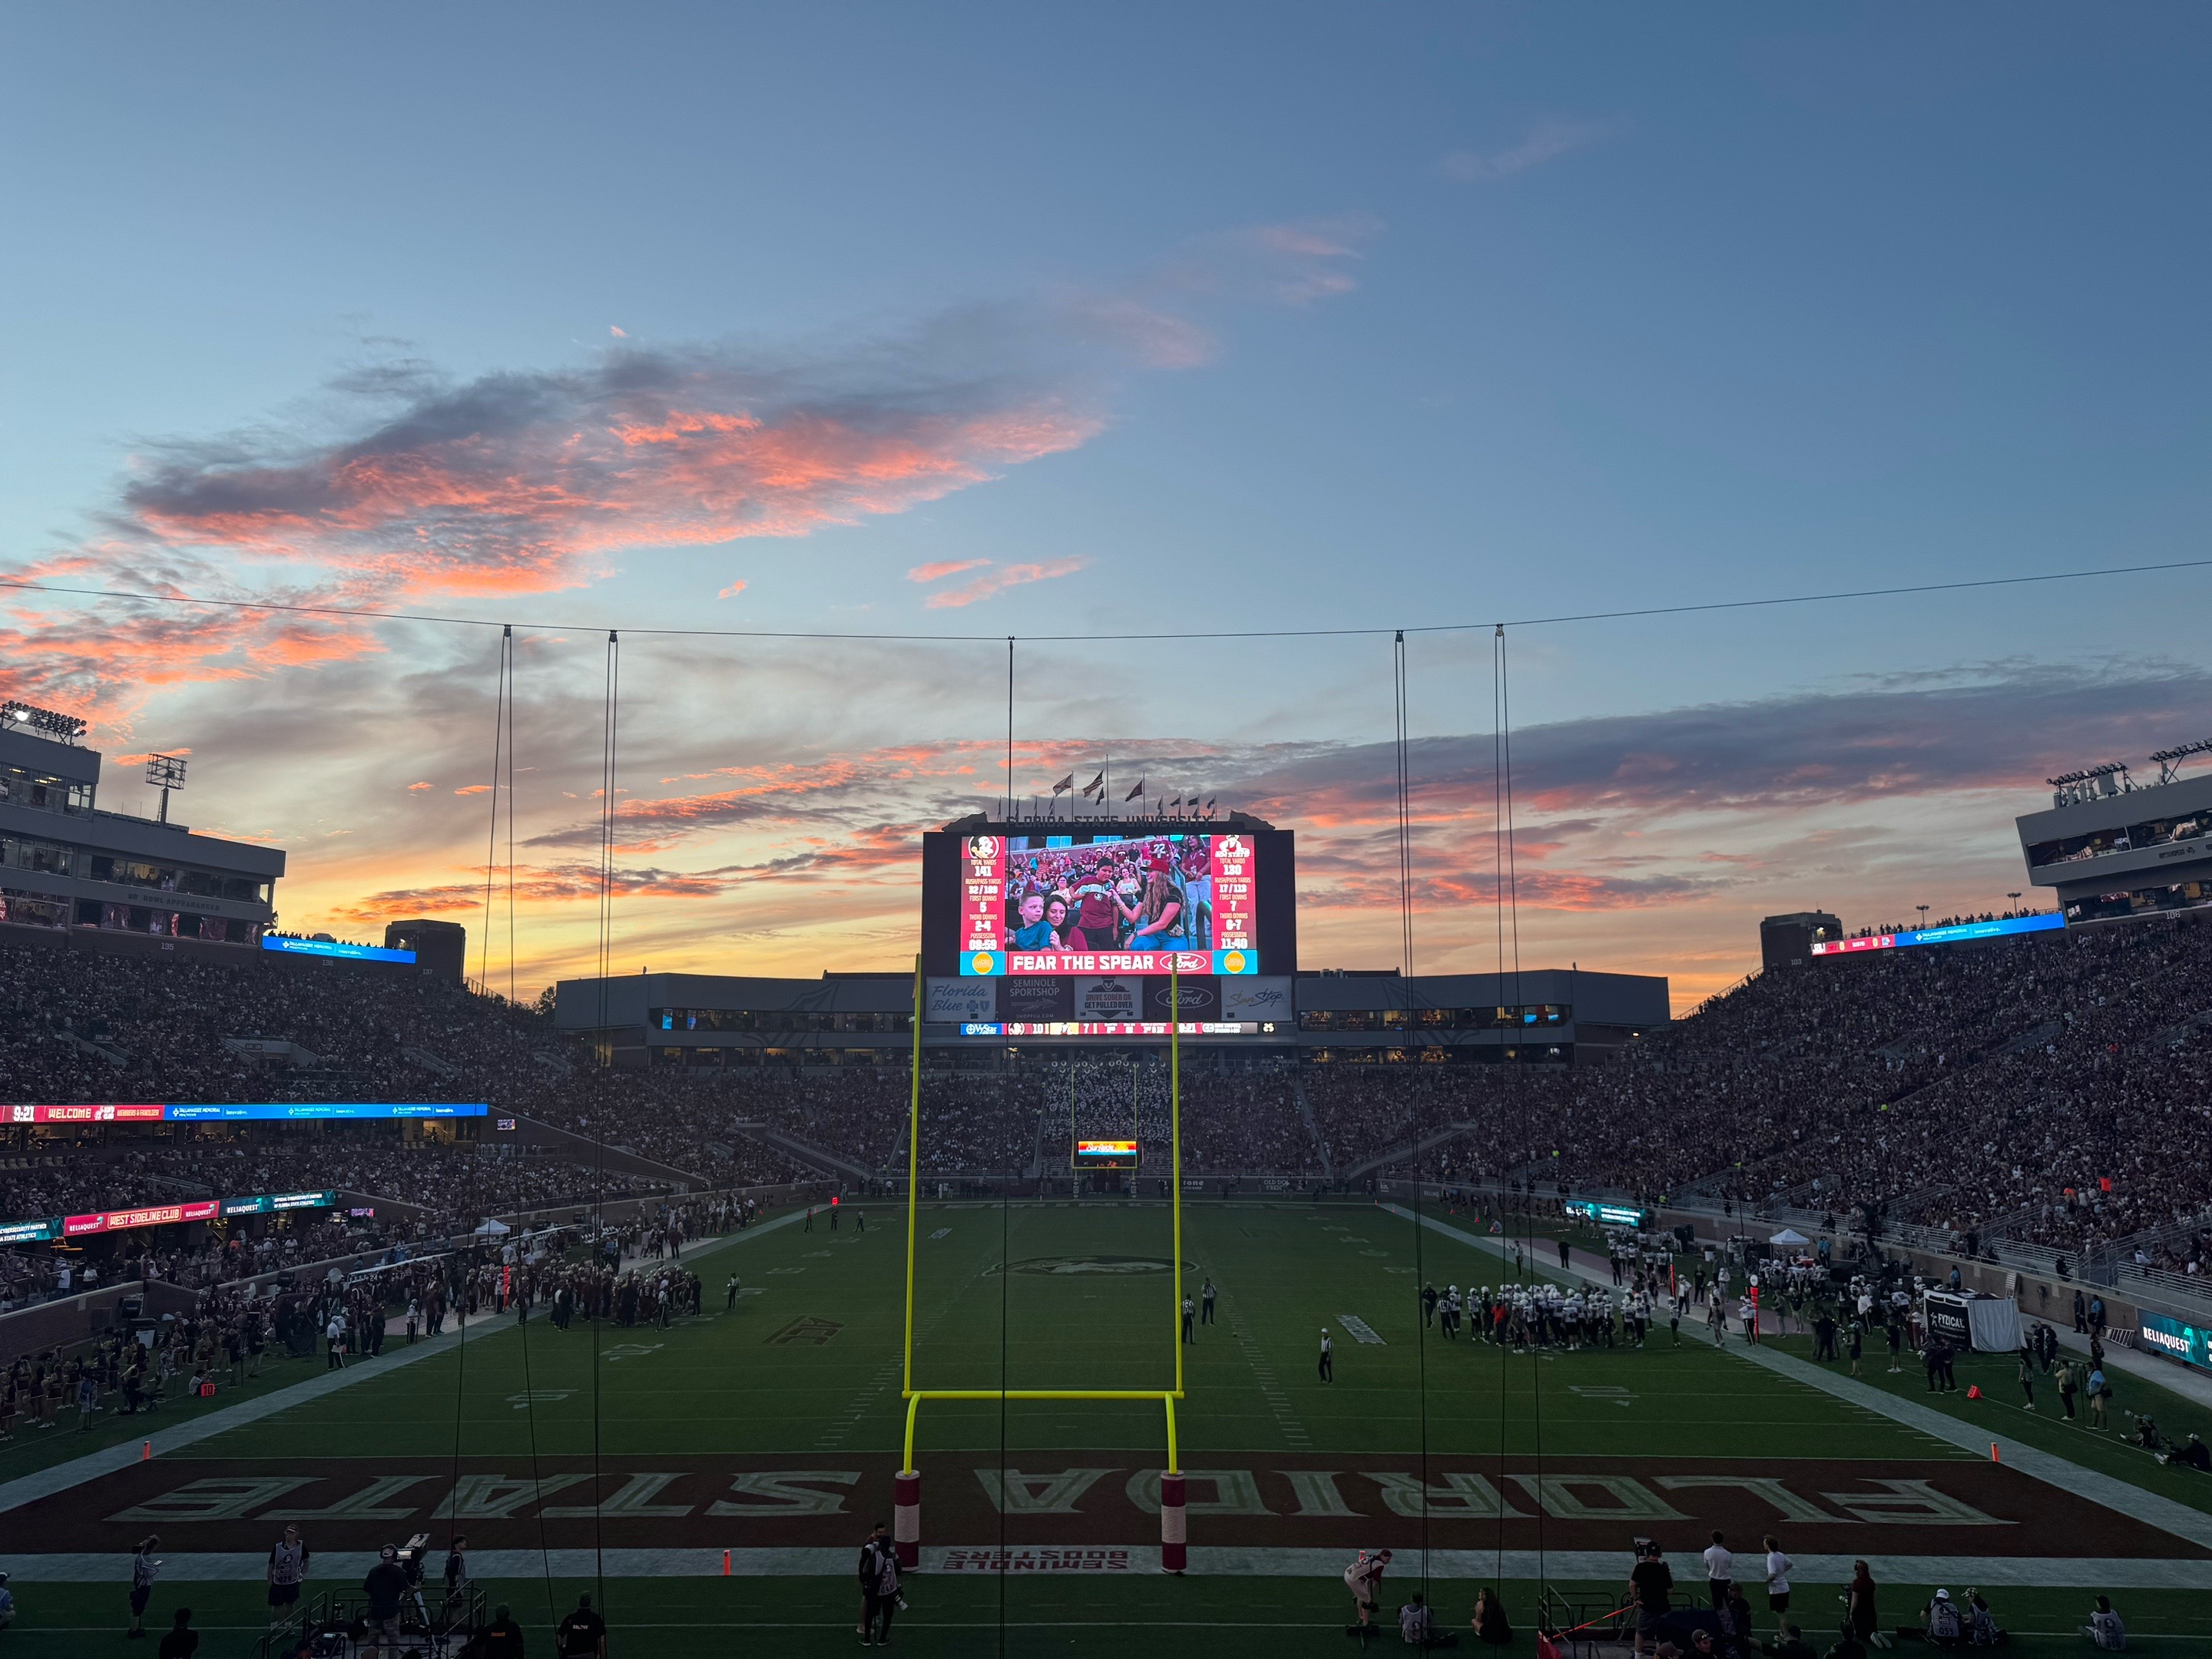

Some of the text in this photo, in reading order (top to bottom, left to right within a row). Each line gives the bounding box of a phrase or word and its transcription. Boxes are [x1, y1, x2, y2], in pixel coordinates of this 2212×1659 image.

[1005, 815, 1210, 828] FLORIDA STATE UNIVERSITY
[975, 866, 992, 876] 141
[1224, 865, 1242, 875] 130
[144, 895, 164, 903] BOWL
[167, 899, 220, 911] APPEARANCES
[979, 902, 987, 912] 5
[1230, 901, 1237, 912] 7
[2166, 911, 2181, 919] 106
[975, 921, 991, 931] 2-4
[1226, 919, 1242, 930] 6-7
[1221, 938, 1248, 949] 11:40
[1012, 955, 1154, 971] FEAR THE SPEAR
[1167, 955, 1197, 969] Ford
[1013, 979, 1056, 987] SEMINOLE
[932, 984, 988, 997] Florida
[1010, 988, 1059, 997] SPORTSHOP
[1166, 991, 1201, 1005] Ford
[931, 999, 962, 1011] Blue
[975, 1024, 997, 1034] VyStar
[1033, 1024, 1043, 1034] 10
[1083, 1024, 1089, 1034] 7
[13, 1105, 35, 1121] 9:21
[48, 1108, 91, 1119] WELCOME
[227, 1204, 260, 1214] RELIAQUEST
[70, 1208, 212, 1232] RELIAQUEST WEST SIDELINE CLUB RELIAQUEST
[1938, 1313, 1965, 1329] FYZICAL
[2143, 1326, 2190, 1353] RELIAQUEST
[204, 1385, 214, 1396] 10
[101, 1470, 861, 1522] STATE
[972, 1468, 2022, 1525] FLORIDA
[947, 1551, 1128, 1560] BOOSTERS
[942, 1560, 1128, 1570] SEMINOLE
